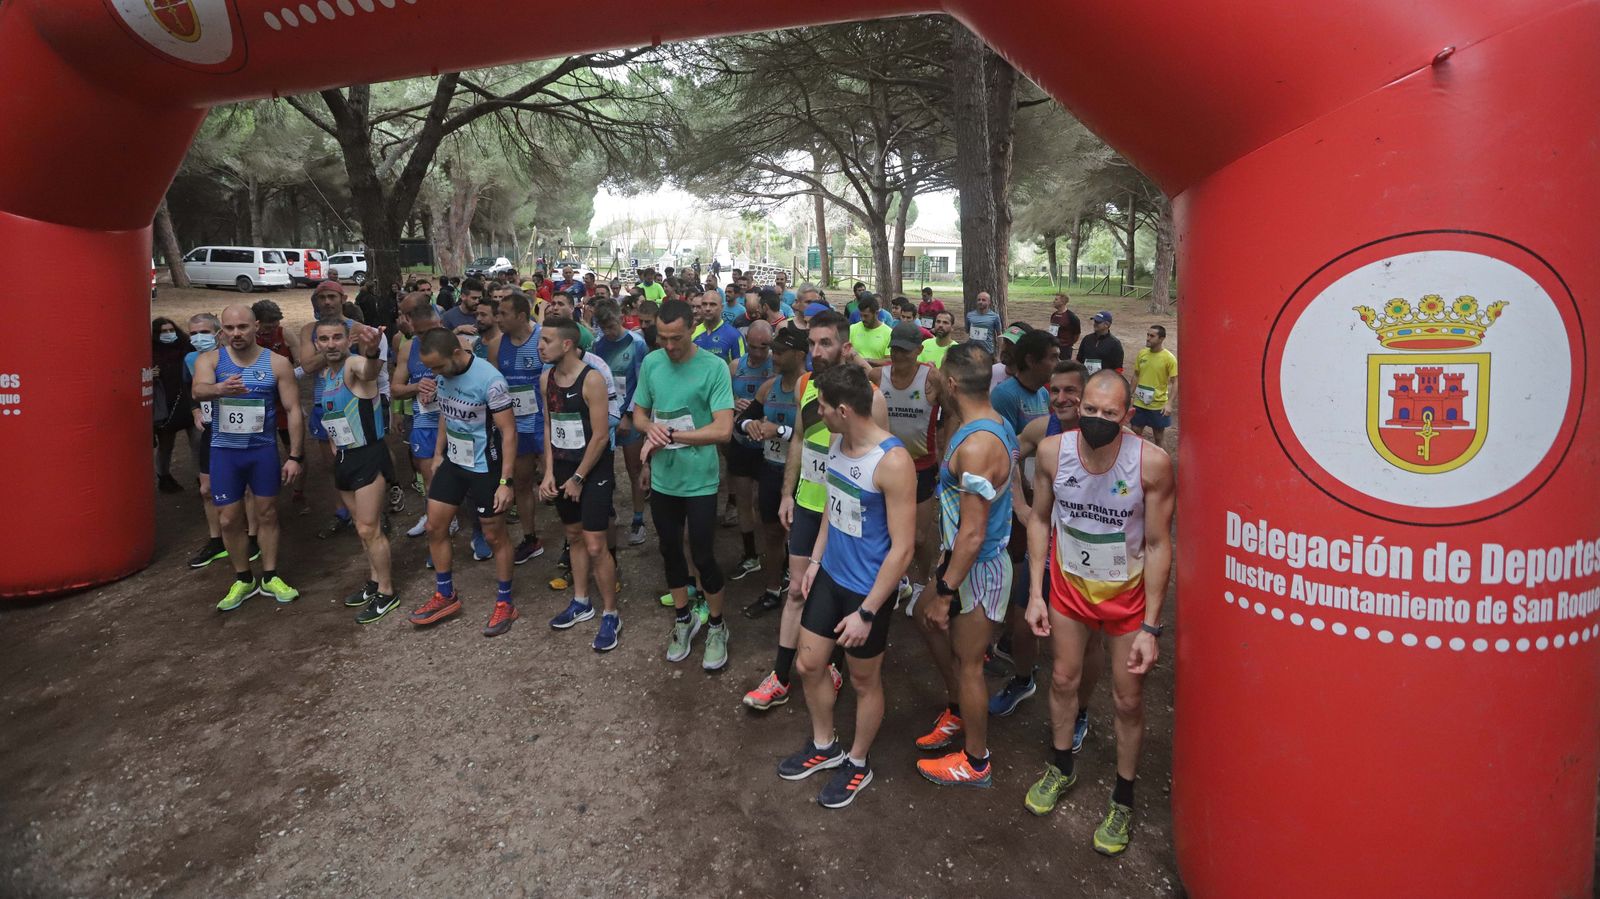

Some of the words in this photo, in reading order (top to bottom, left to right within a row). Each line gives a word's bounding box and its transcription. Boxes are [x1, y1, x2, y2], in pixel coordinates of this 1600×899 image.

[511, 398, 521, 408] 62
[229, 412, 244, 424] 63
[328, 426, 338, 438] 58
[556, 427, 566, 439] 99
[448, 441, 458, 455] 78
[770, 440, 781, 453] 22
[812, 459, 826, 474] 14
[831, 495, 842, 515] 74
[1059, 499, 1084, 511] CLUB
[1086, 503, 1134, 518] TRIATLÓN
[1069, 510, 1124, 527] ALGECIRAS
[1226, 510, 1413, 581] Delegación
[1422, 542, 1472, 585] de
[1081, 550, 1091, 567] 2
[1225, 555, 1286, 596] Ilustre
[1290, 574, 1470, 624] Ayuntamiento
[1476, 595, 1507, 625] de
[1512, 594, 1553, 625] San
[1557, 585, 1600, 622] Roque
